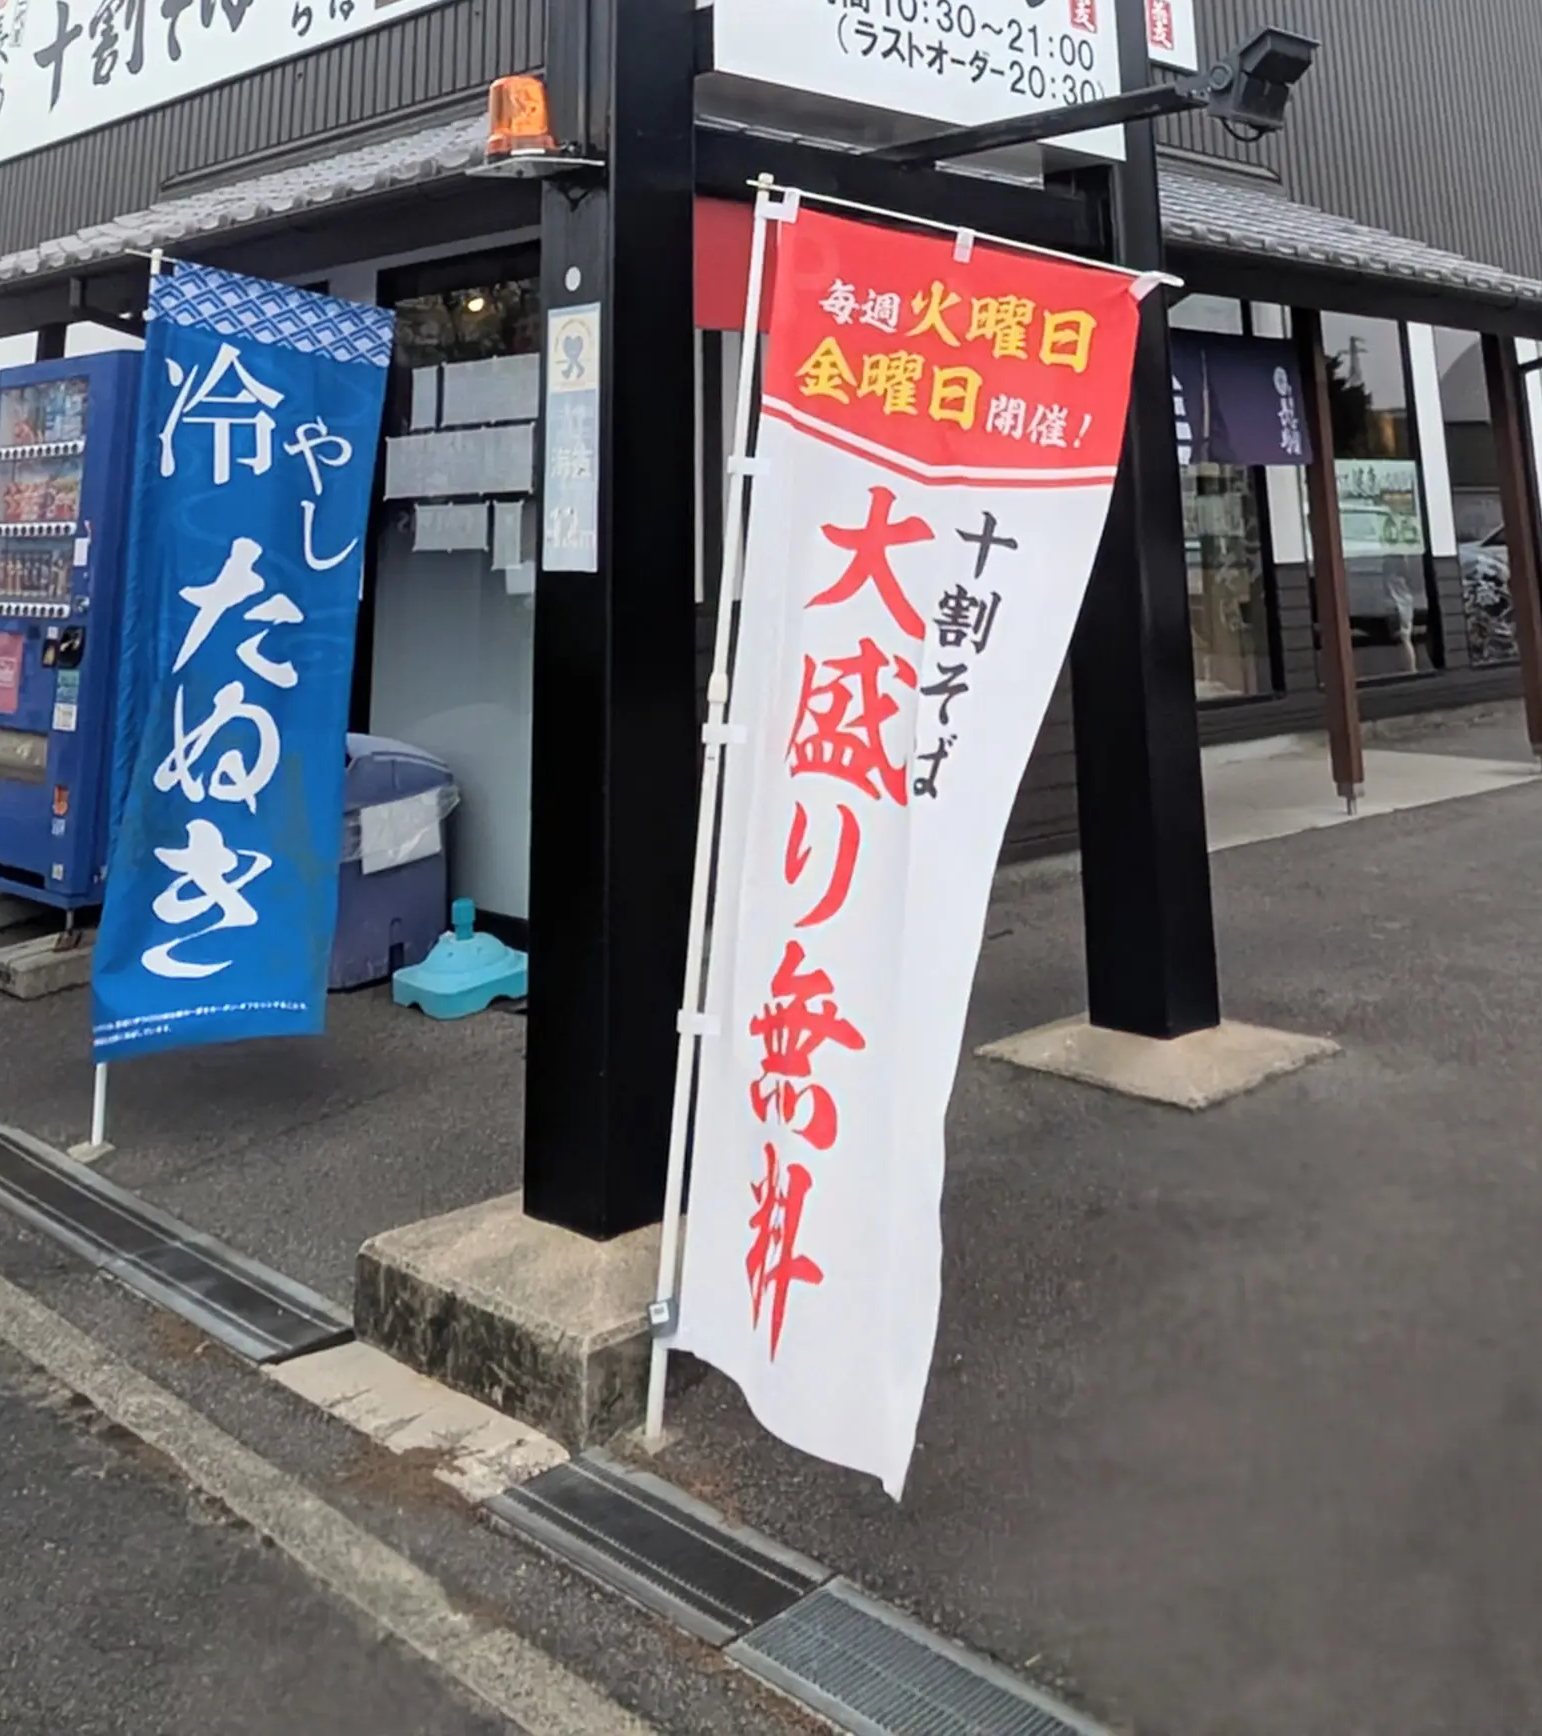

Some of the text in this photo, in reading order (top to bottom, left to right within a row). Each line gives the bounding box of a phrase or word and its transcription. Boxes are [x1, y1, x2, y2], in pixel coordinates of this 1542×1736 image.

[794, 335, 1093, 450] 金曜日開催！
[817, 278, 1099, 375] 毎週火曜日
[912, 510, 1020, 800] 十割そば
[744, 485, 927, 1363] 大盛り無料
